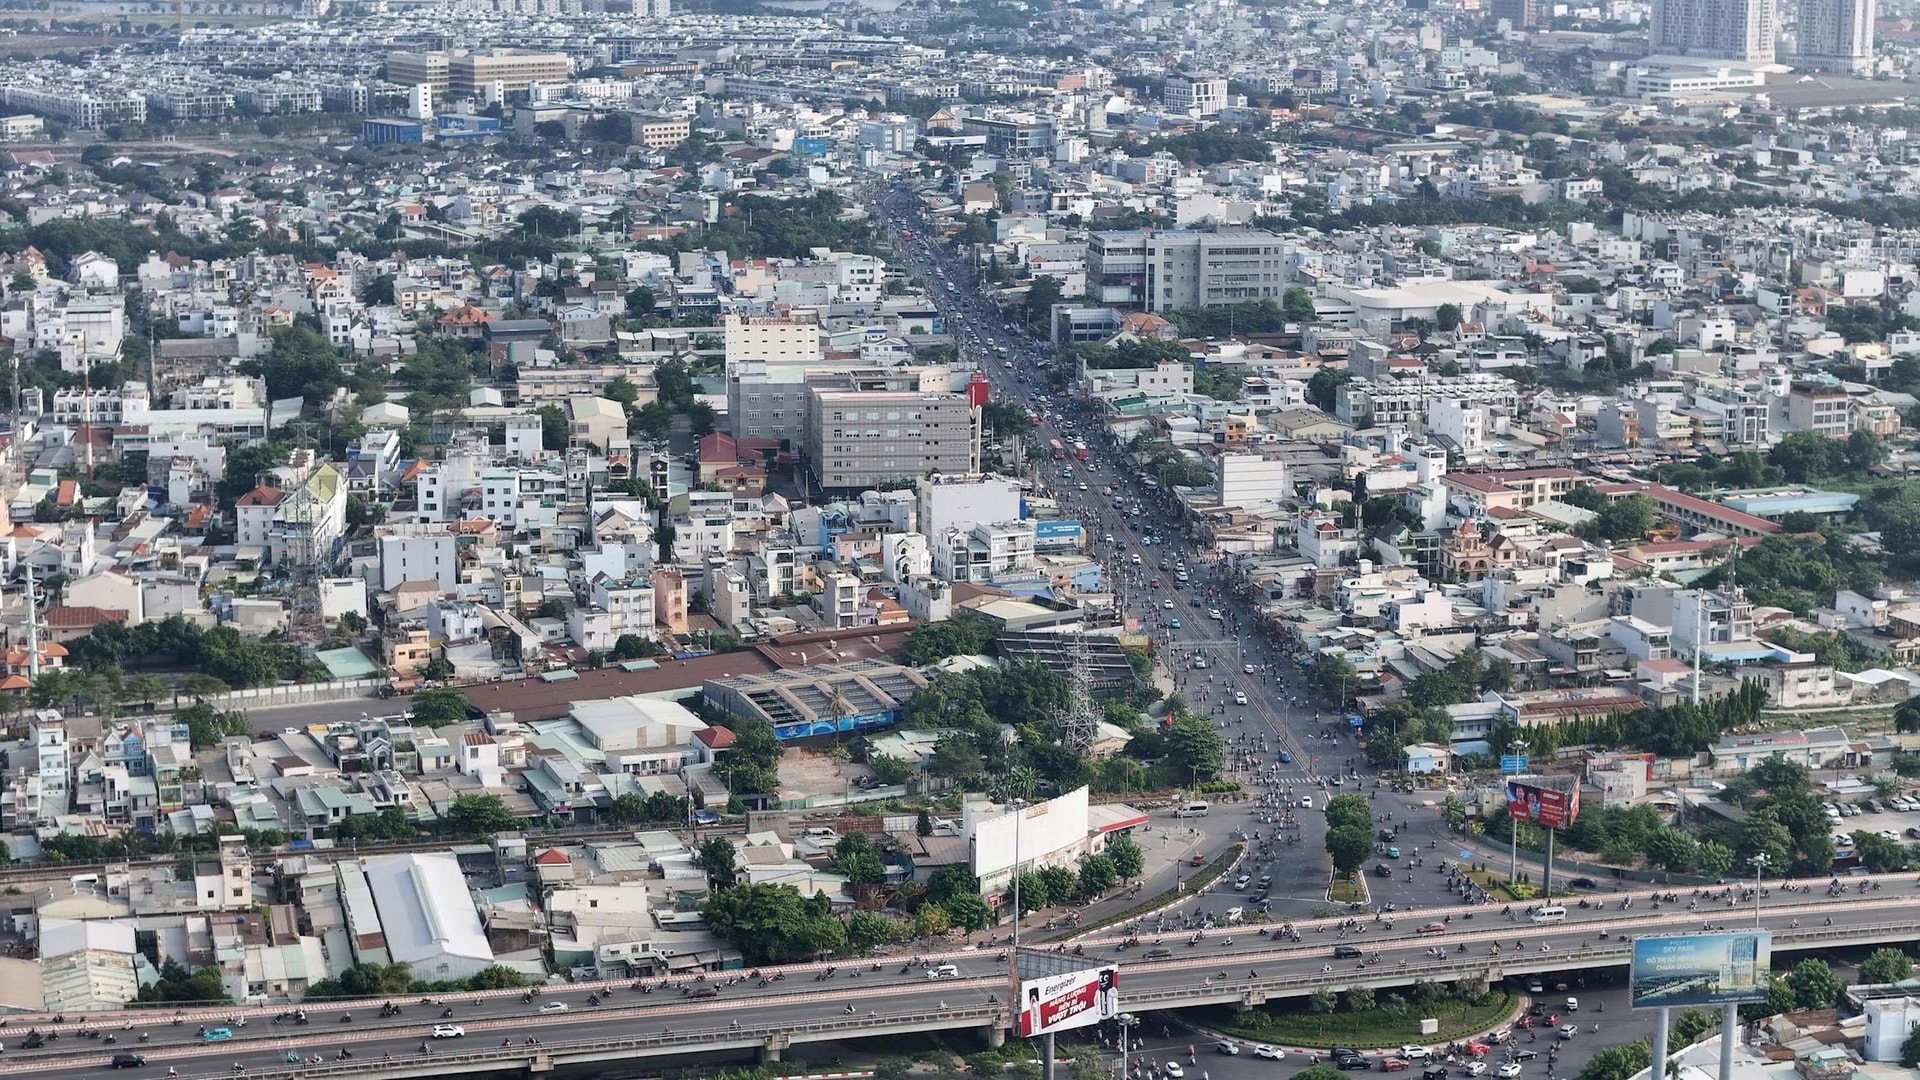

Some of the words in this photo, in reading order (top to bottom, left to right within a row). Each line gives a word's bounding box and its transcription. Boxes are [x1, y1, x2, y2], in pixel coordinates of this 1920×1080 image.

[1677, 945, 1696, 953] PARK
[1045, 977, 1076, 995] Energizer
[1048, 1010, 1069, 1024] VƯỢT
